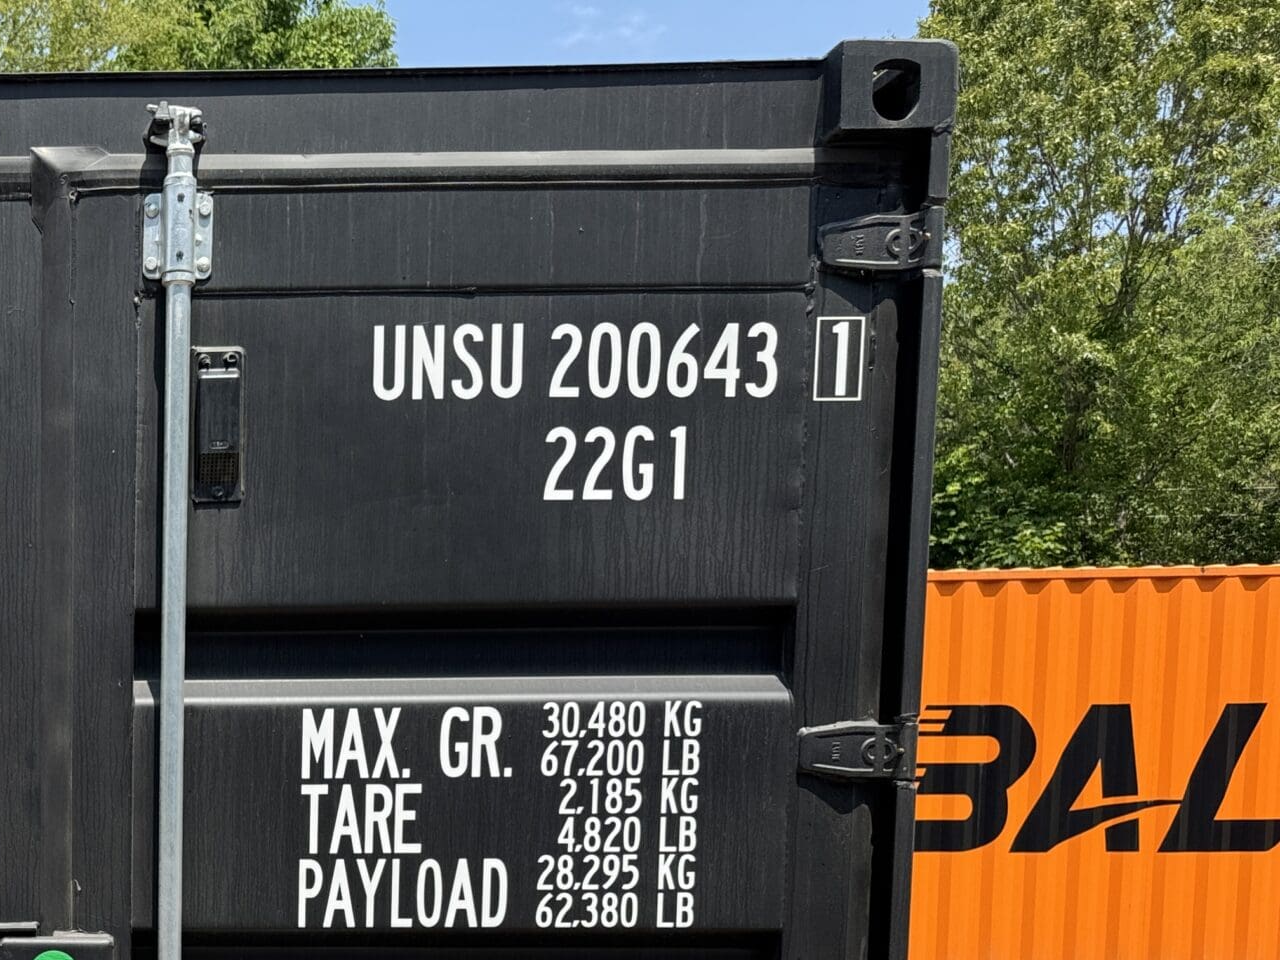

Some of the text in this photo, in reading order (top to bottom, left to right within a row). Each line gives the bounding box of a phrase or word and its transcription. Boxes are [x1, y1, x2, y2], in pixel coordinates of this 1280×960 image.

[372, 321, 850, 401] UNSU 200643 1
[542, 424, 687, 501] 22G1
[541, 700, 703, 739] 30,480 KG
[301, 706, 513, 779] MAX. GR.
[540, 739, 701, 777] 67,200 LB
[558, 777, 699, 816] 2,185 KG
[301, 783, 422, 855] TARE
[557, 816, 697, 854] 4,820 LB
[536, 853, 696, 892] 28,295 KG
[297, 858, 508, 928] PAYLOAD
[535, 891, 694, 929] 62,380 LB
